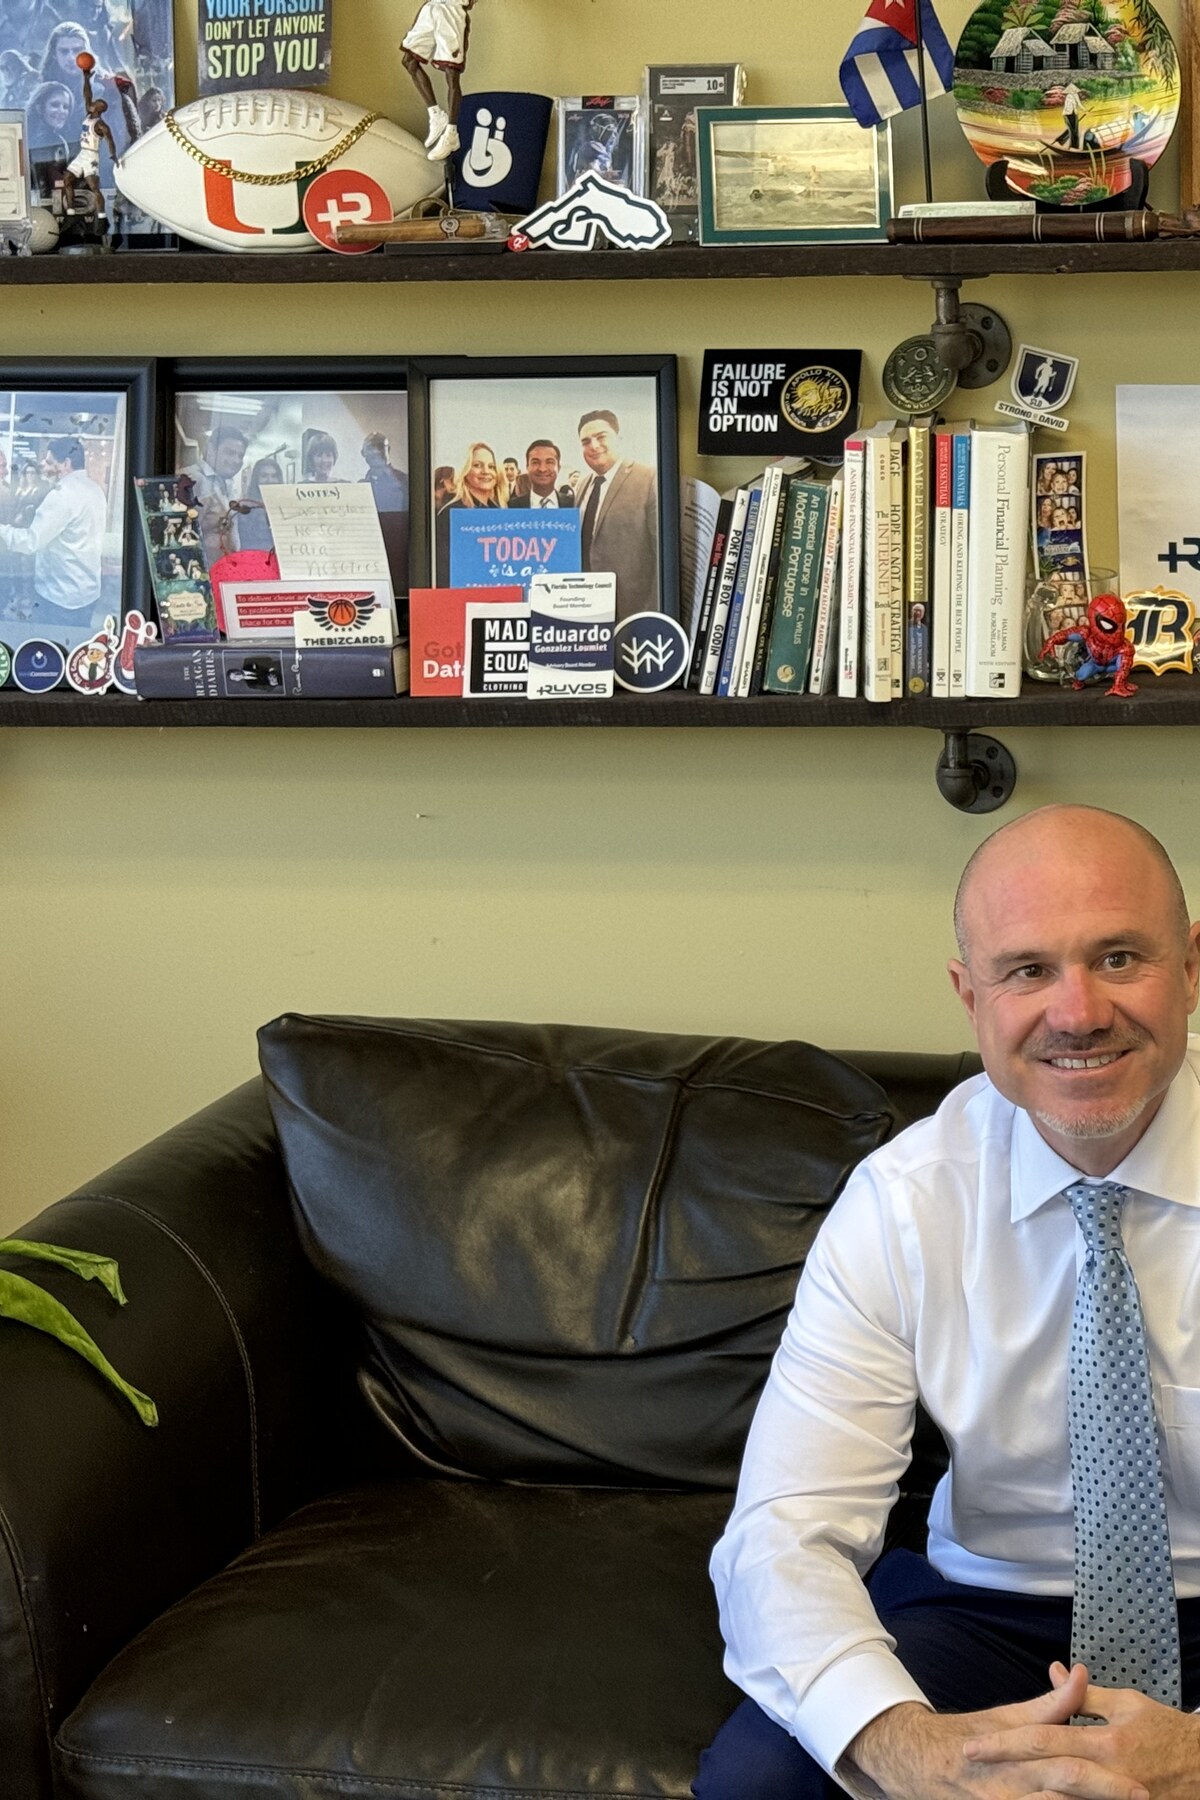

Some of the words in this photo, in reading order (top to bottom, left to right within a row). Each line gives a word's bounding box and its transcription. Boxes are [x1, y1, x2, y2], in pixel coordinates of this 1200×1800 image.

[206, 0, 250, 19] YOUR
[254, 0, 325, 17] PURSUIT
[205, 20, 244, 40] DON'T
[248, 18, 270, 39] LET
[274, 14, 325, 36] ANYONE
[207, 42, 265, 79] STOP
[273, 38, 325, 73] YOU.
[707, 79, 718, 91] 10
[712, 363, 787, 380] FAILURE
[791, 368, 823, 388] APOLLO
[825, 370, 841, 385] XIII
[711, 381, 729, 397] IS
[733, 380, 773, 397] NOT
[709, 397, 738, 414] AN
[998, 402, 1033, 419] STRONG
[1038, 415, 1066, 429] DAVID
[709, 414, 779, 433] OPTION
[889, 448, 902, 477] PAGE
[914, 450, 924, 490] GAME
[997, 444, 1011, 496] Personal
[849, 467, 857, 499] ANALYSIS
[939, 463, 948, 505] ESSENTIALS
[957, 465, 966, 507] ESSENTIALS
[748, 501, 760, 527] RETURN
[778, 491, 787, 514] RICH
[809, 494, 821, 509] An
[875, 510, 889, 519] The
[914, 494, 924, 526] PLAN
[791, 491, 809, 540] Modern
[890, 504, 902, 535] HOPE
[939, 510, 947, 547] STRATEGY
[956, 512, 964, 541] HIRING
[995, 498, 1010, 551] Financial
[730, 529, 743, 558] POKE
[745, 528, 755, 539] ON
[773, 515, 785, 547] HABITS
[805, 511, 819, 551] Essential
[848, 513, 857, 556] FINANCIAL
[477, 536, 558, 563] TODAY
[890, 542, 902, 553] IS
[914, 531, 924, 561] FOR
[956, 542, 964, 559] AND
[501, 563, 518, 577] is
[520, 566, 534, 577] a
[726, 557, 738, 582] THE
[737, 539, 754, 595] RELATIONSHIP
[801, 552, 814, 585] Course
[877, 523, 890, 599] INTERNET
[890, 554, 902, 583] NOT
[781, 545, 802, 618] Portuguese
[799, 587, 809, 597] in
[846, 556, 856, 610] MANAGEMENT
[891, 585, 902, 593] A
[914, 566, 924, 596] LIFE
[990, 553, 1009, 606] Planning
[247, 594, 270, 602] deliver
[274, 593, 298, 601] clever
[719, 581, 732, 606] BOX
[874, 601, 891, 609] Book
[955, 594, 963, 607] THE
[240, 619, 262, 629] place
[263, 619, 273, 627] for
[275, 618, 288, 627] the
[250, 606, 283, 616] problems
[955, 608, 963, 626] BEST
[531, 624, 612, 644] Eduardo
[709, 624, 725, 657] GODIN
[890, 600, 902, 655] STRATEGY
[954, 627, 963, 654] PEOPLE
[534, 645, 573, 654] Gonzalez
[192, 649, 206, 697] REAGAN
[207, 649, 219, 697] DIARIES
[482, 682, 524, 692] CLOTHING
